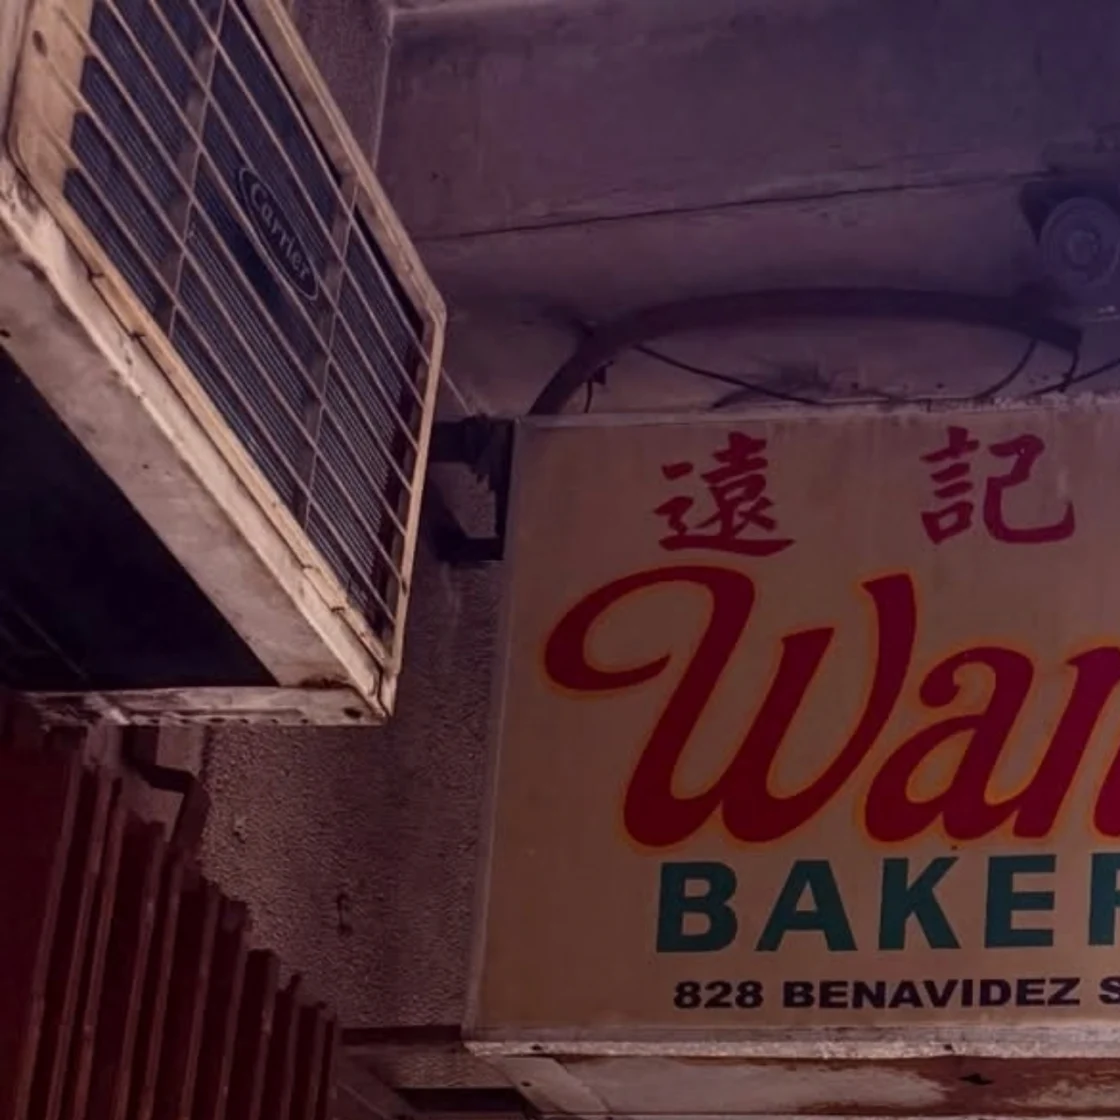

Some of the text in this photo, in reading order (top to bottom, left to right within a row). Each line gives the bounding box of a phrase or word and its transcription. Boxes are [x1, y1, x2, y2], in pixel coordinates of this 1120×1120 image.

[251, 182, 311, 280] Carrier
[673, 980, 764, 1010] 828
[782, 977, 1081, 1009] BENAVIDEZ
